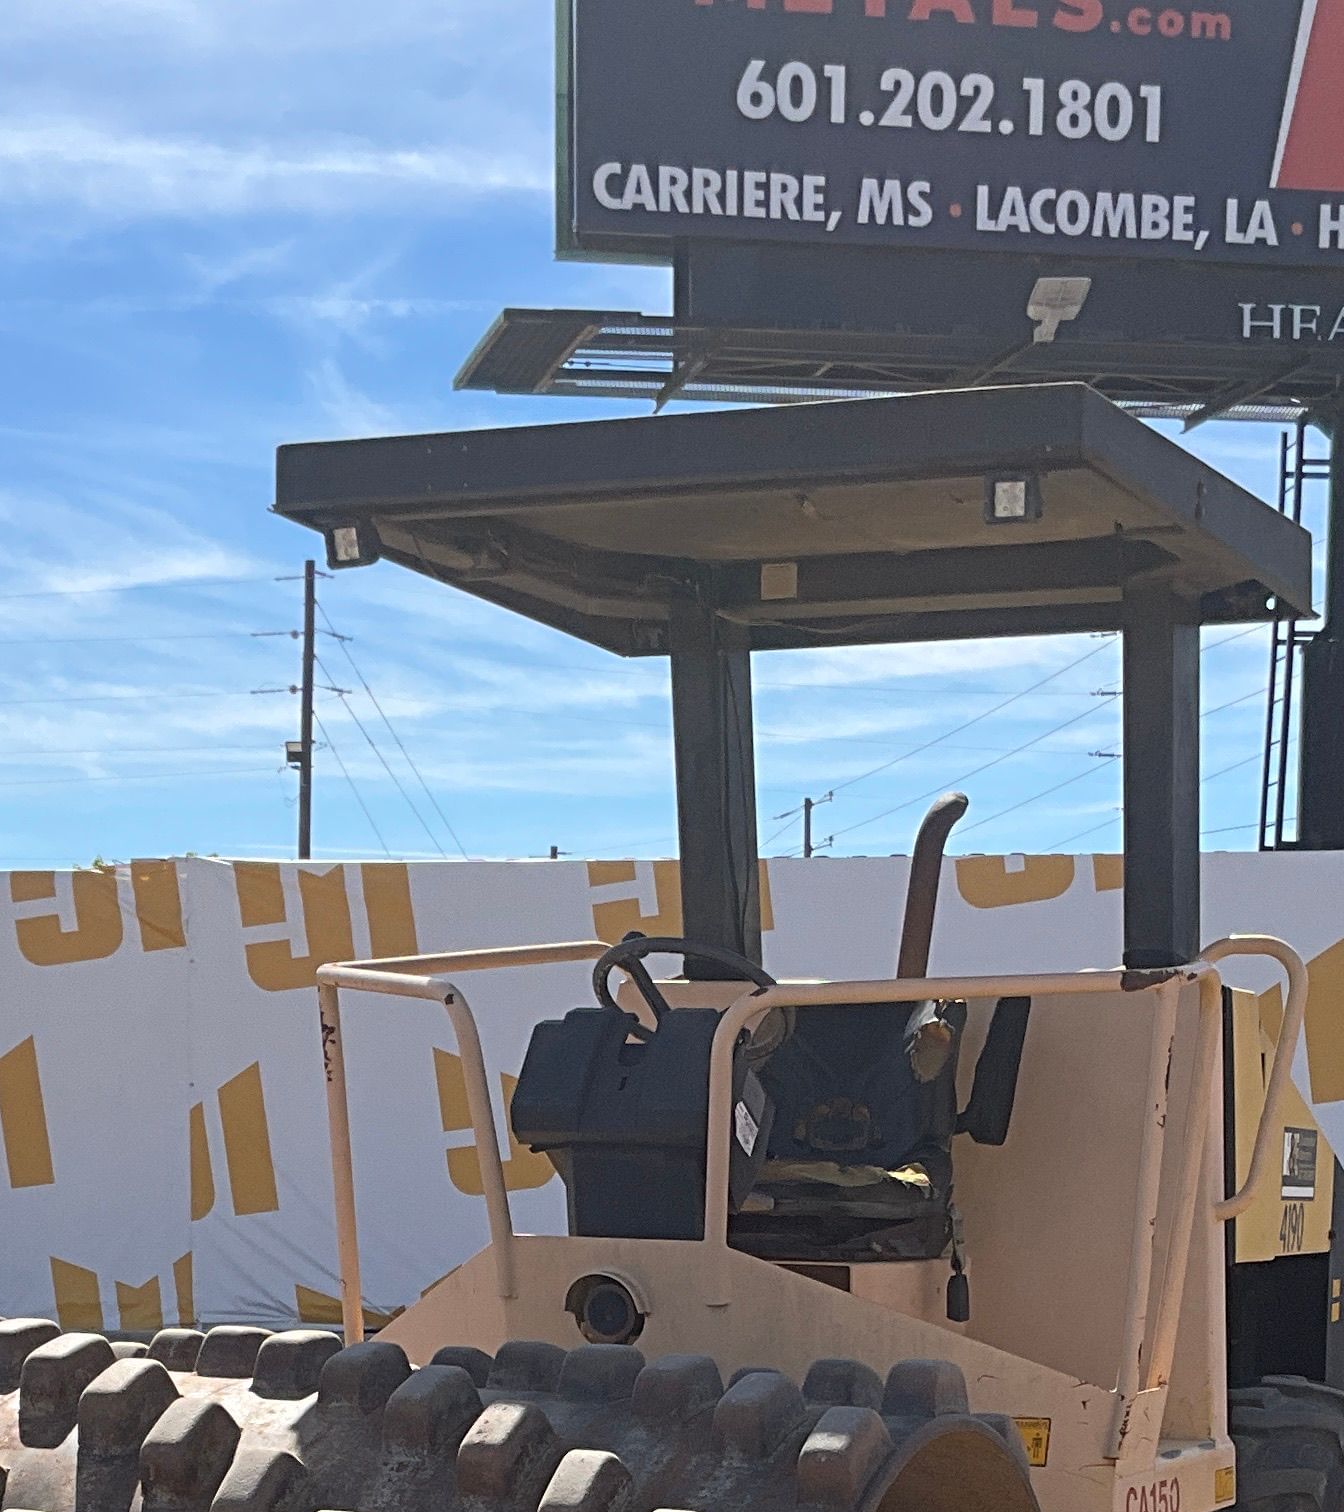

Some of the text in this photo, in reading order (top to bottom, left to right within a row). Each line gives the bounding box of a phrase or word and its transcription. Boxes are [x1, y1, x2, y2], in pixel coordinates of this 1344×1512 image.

[735, 59, 1162, 143] 601.202.1801
[592, 161, 843, 232] CARRIERE,
[857, 177, 934, 228] MS
[975, 184, 1210, 251] LACOMBE,
[1225, 198, 1279, 246] LA
[1279, 1201, 1305, 1253] 4190
